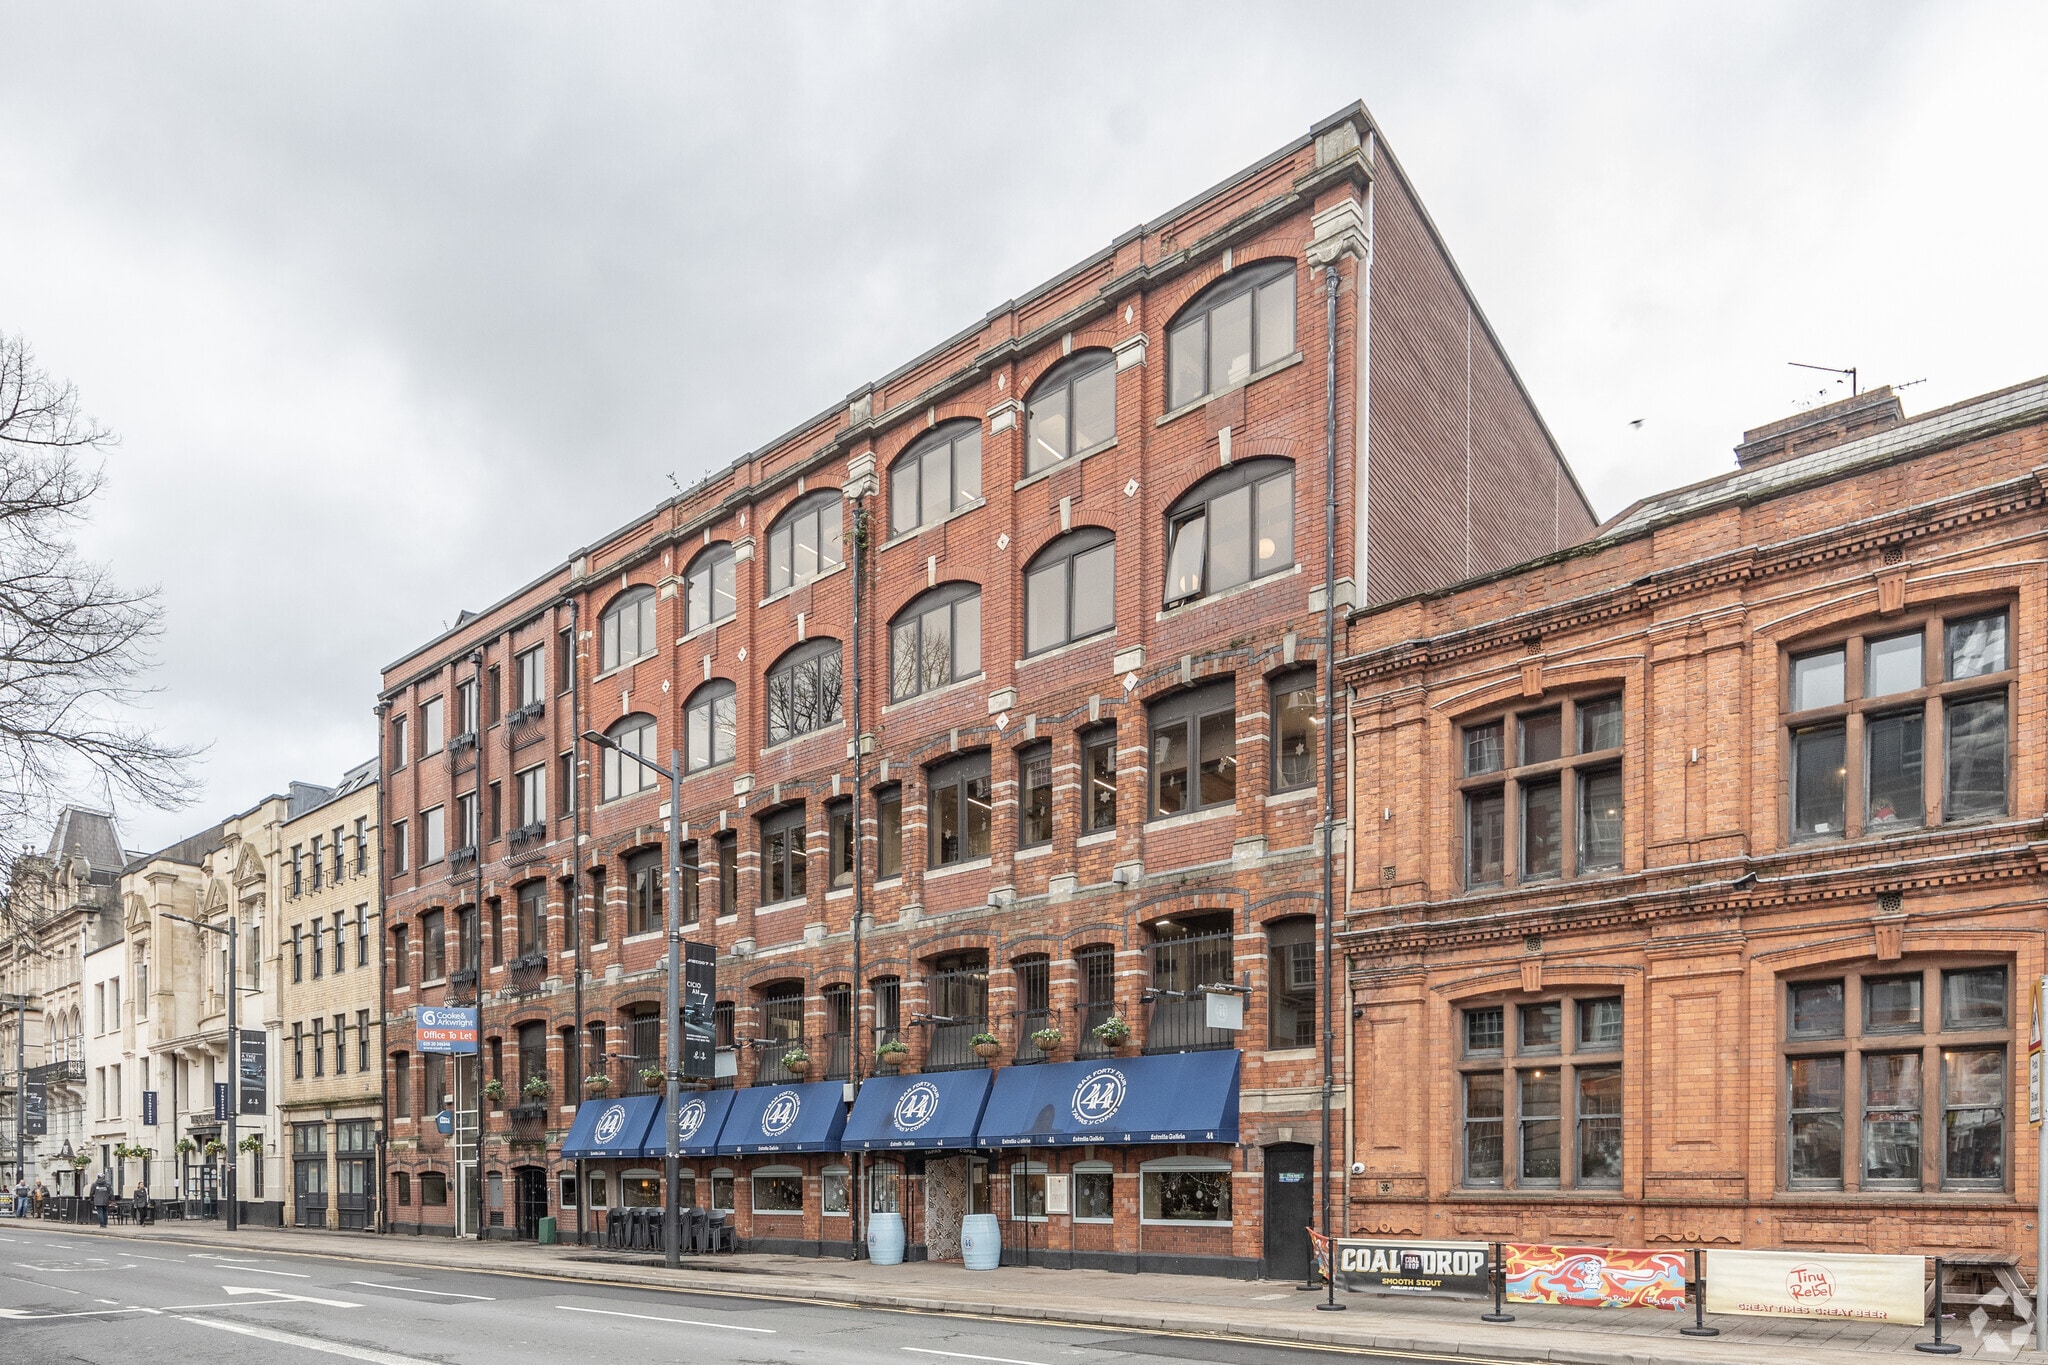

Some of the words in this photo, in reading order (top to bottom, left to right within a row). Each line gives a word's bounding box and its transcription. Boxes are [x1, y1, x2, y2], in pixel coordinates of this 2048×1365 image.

[699, 992, 708, 1005] 7
[436, 1011, 466, 1020] Cooke&
[437, 1018, 473, 1028] Arkwright
[423, 1030, 446, 1039] Office
[448, 1031, 457, 1039] To
[460, 1031, 473, 1040] Let
[1093, 1067, 1116, 1077] FORTY
[912, 1081, 931, 1090] FORTY
[1080, 1082, 1115, 1110] 44
[768, 1102, 792, 1124] 44
[901, 1094, 929, 1119] 44
[600, 1114, 620, 1134] 44
[679, 1109, 700, 1130] 44
[1205, 1131, 1214, 1140] 44
[1340, 1248, 1401, 1274] COAL
[1422, 1250, 1484, 1276] DROP
[1404, 1256, 1420, 1264] COAL
[1381, 1277, 1415, 1286] SMOOTH
[1416, 1278, 1442, 1287] STOUT
[1790, 1268, 1827, 1285] Tiny
[1790, 1282, 1833, 1299] Rebel
[1644, 1296, 1660, 1306] Tiny
[1660, 1297, 1679, 1306] Rebel
[1737, 1303, 1774, 1312] GREAT
[1775, 1305, 1810, 1314] TIMES
[1813, 1307, 1853, 1317] GREAT
[1854, 1309, 1888, 1319] BEER
